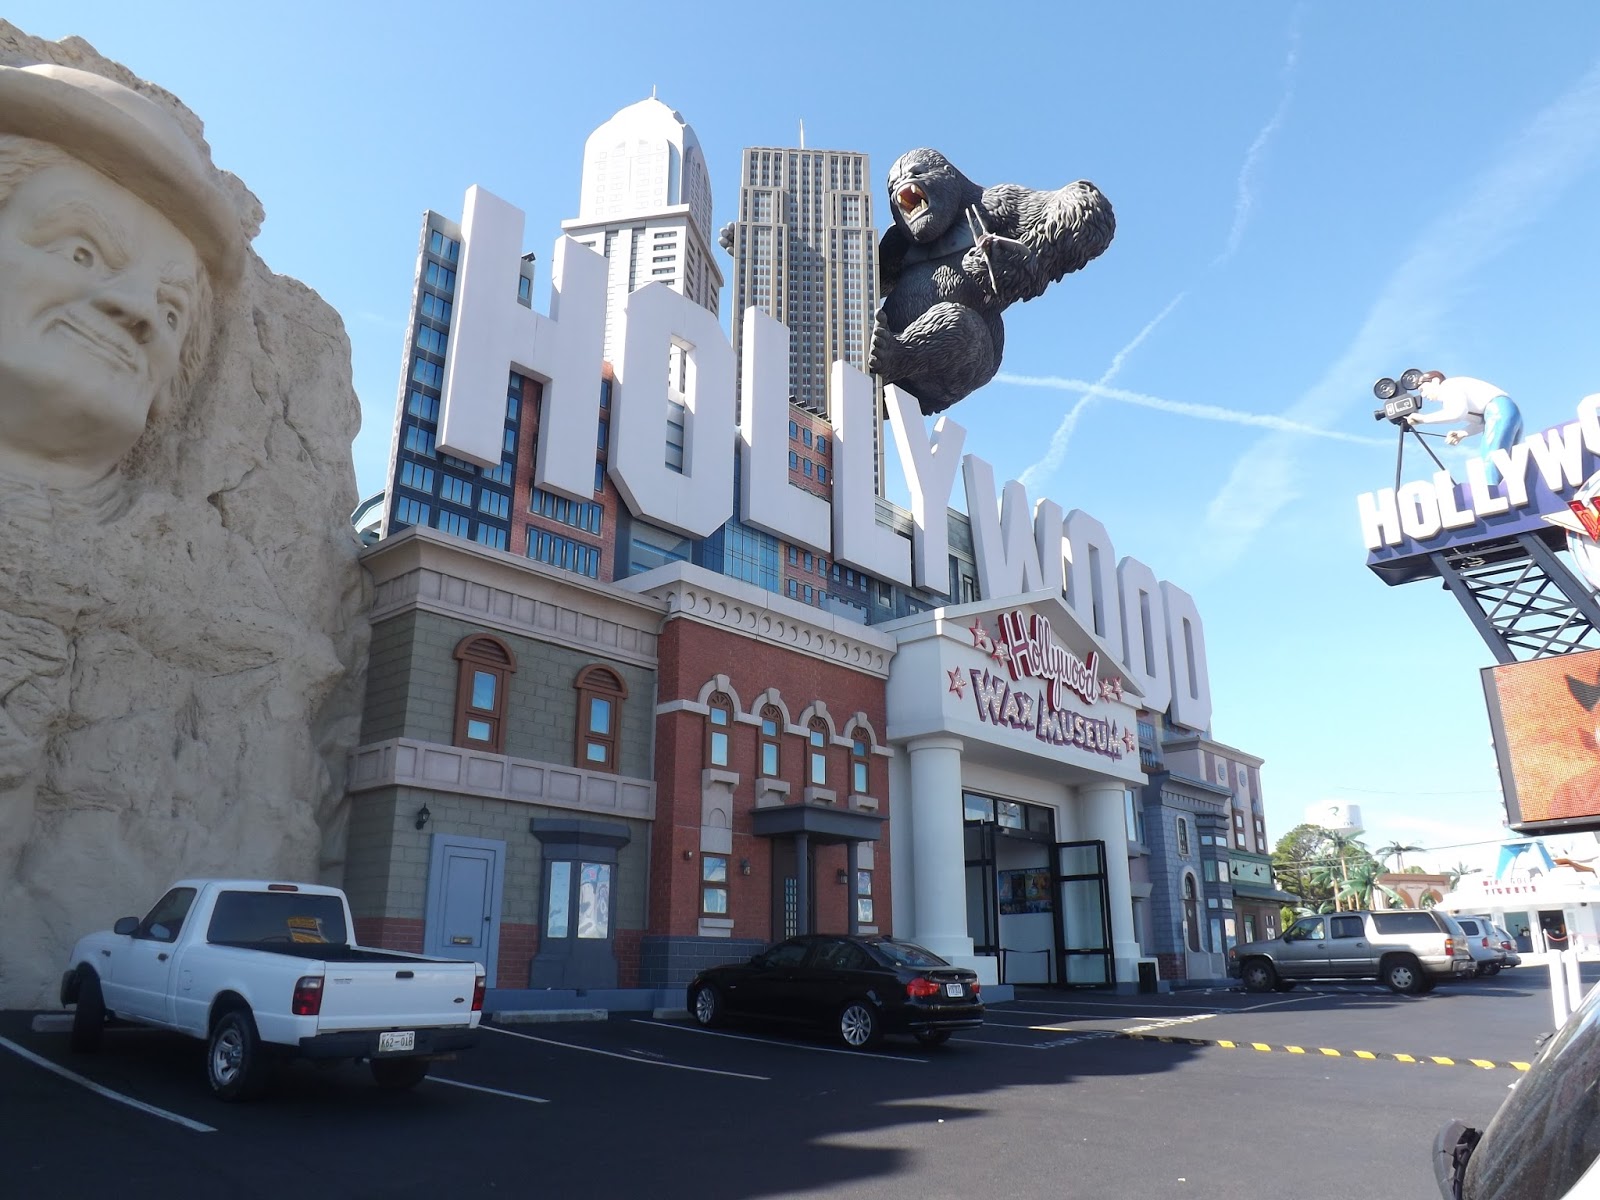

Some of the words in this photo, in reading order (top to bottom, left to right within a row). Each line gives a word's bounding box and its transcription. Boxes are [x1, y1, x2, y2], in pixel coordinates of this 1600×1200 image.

[436, 184, 1212, 732] HOLLYWOOD
[998, 610, 1099, 711] Hollywood
[969, 667, 1035, 731] WAX
[1036, 690, 1122, 762] MUSEUM
